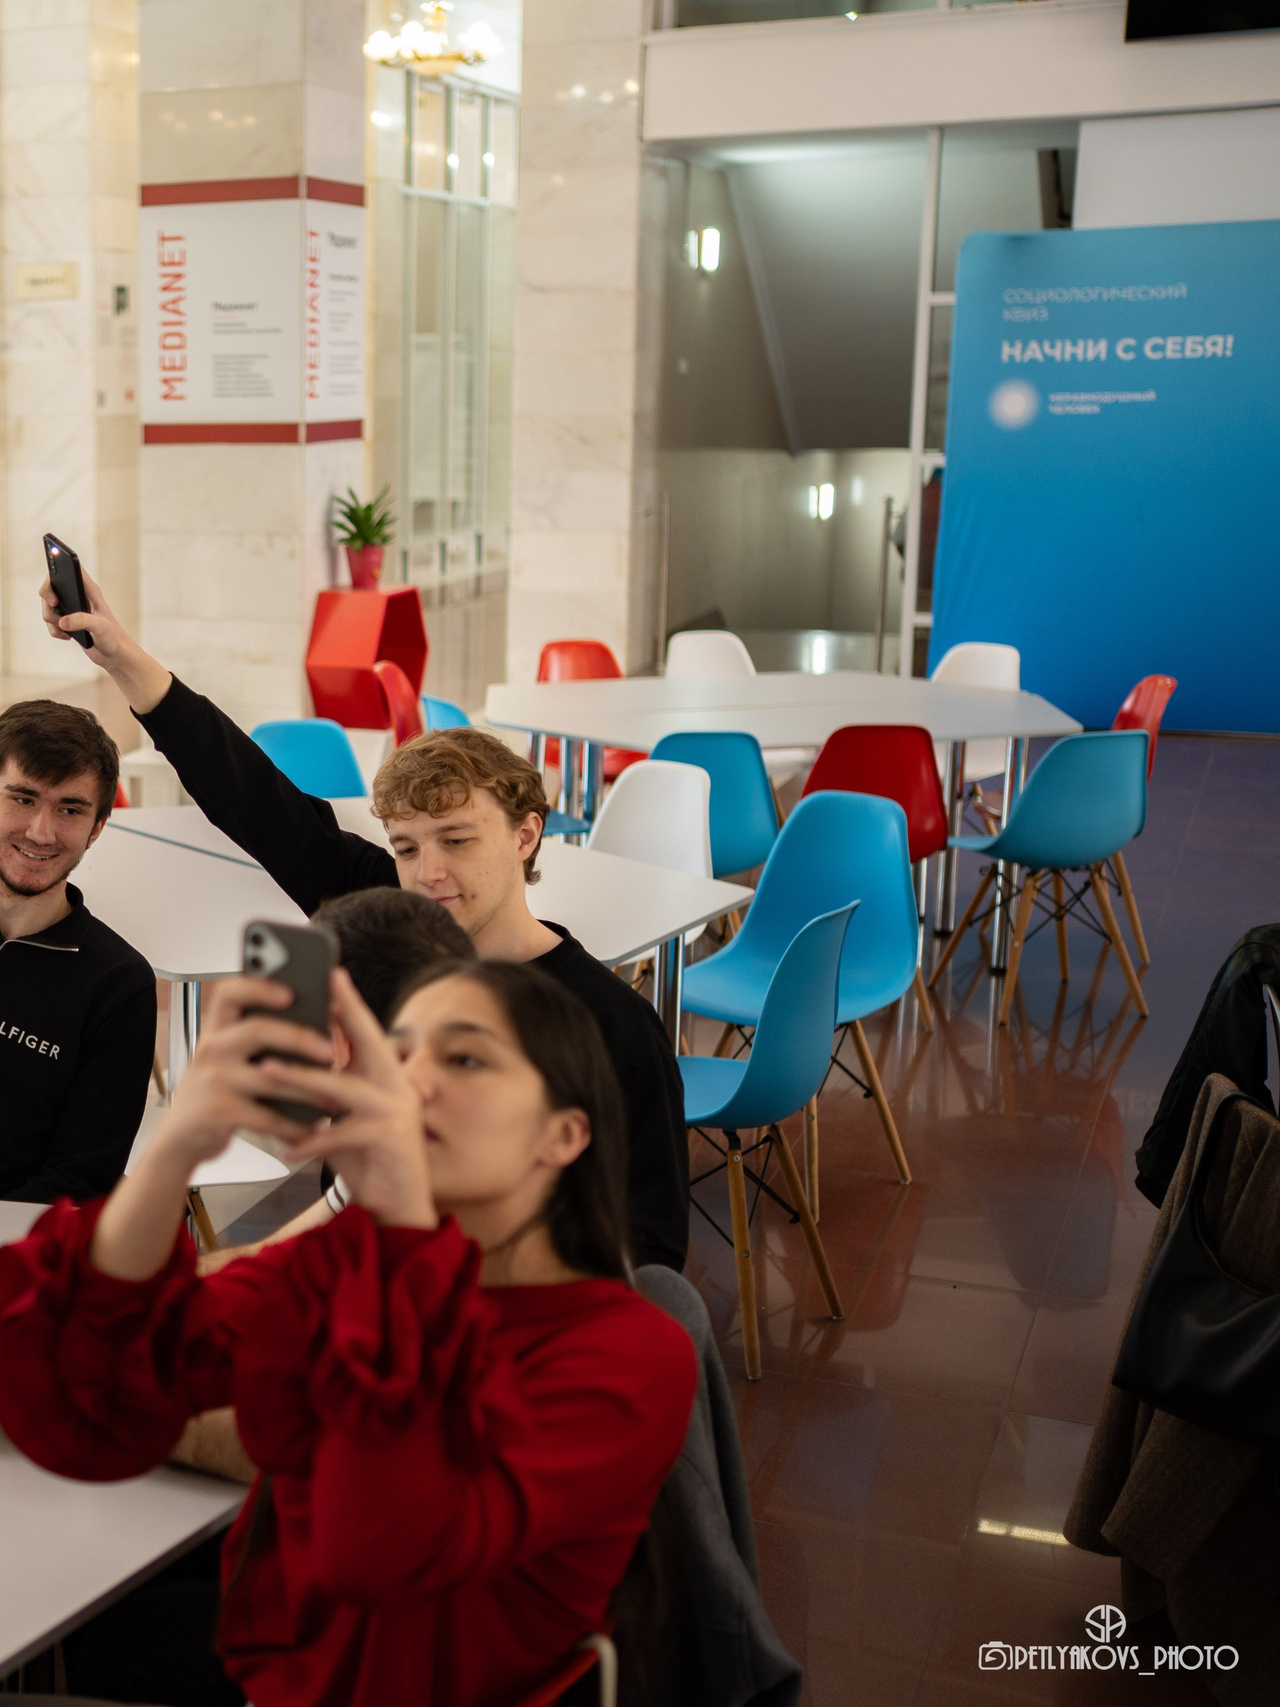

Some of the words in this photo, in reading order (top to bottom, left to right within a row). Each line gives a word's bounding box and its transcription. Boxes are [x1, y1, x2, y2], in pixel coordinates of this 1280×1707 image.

[1002, 282, 1188, 304] СОЦИОЛОГИЧЕСКИЙ
[157, 229, 187, 401] MEDIANET
[306, 225, 320, 399] MEDIANET
[1002, 306, 1049, 322] КВИЗ
[1001, 338, 1108, 363] НАЧНИ
[1115, 337, 1138, 360] С
[1143, 334, 1235, 360] СЕБЯ!
